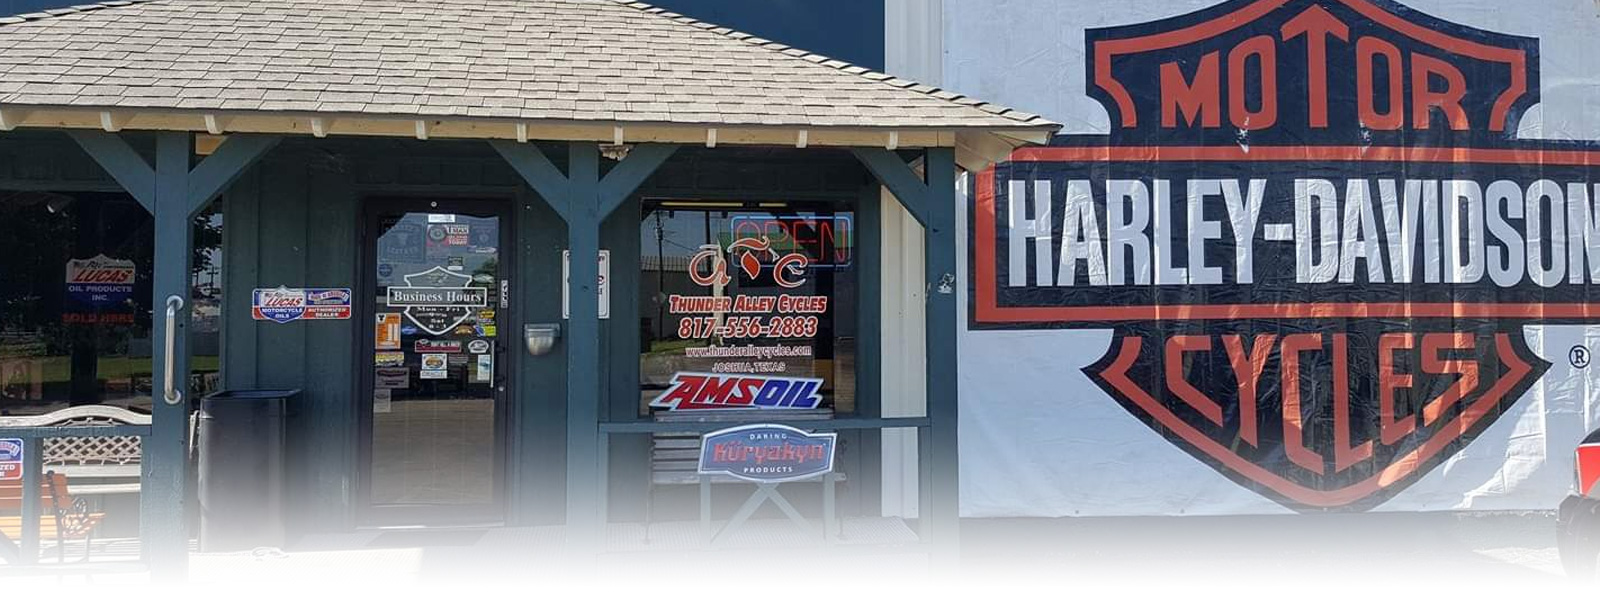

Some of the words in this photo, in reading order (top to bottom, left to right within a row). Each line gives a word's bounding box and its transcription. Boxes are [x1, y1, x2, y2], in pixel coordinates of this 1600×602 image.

[1158, 5, 1469, 131] MOTOR
[1007, 177, 1600, 288] HARLEY-DAVIDSON
[73, 269, 132, 282] LUCAS
[393, 291, 443, 302] Business
[446, 291, 482, 302] Hours
[678, 316, 818, 339] 817-556-2883
[685, 344, 812, 359] www.thunderalleycycles.com
[653, 373, 822, 411] AMSOIL
[1164, 332, 1479, 476] CYCLES
